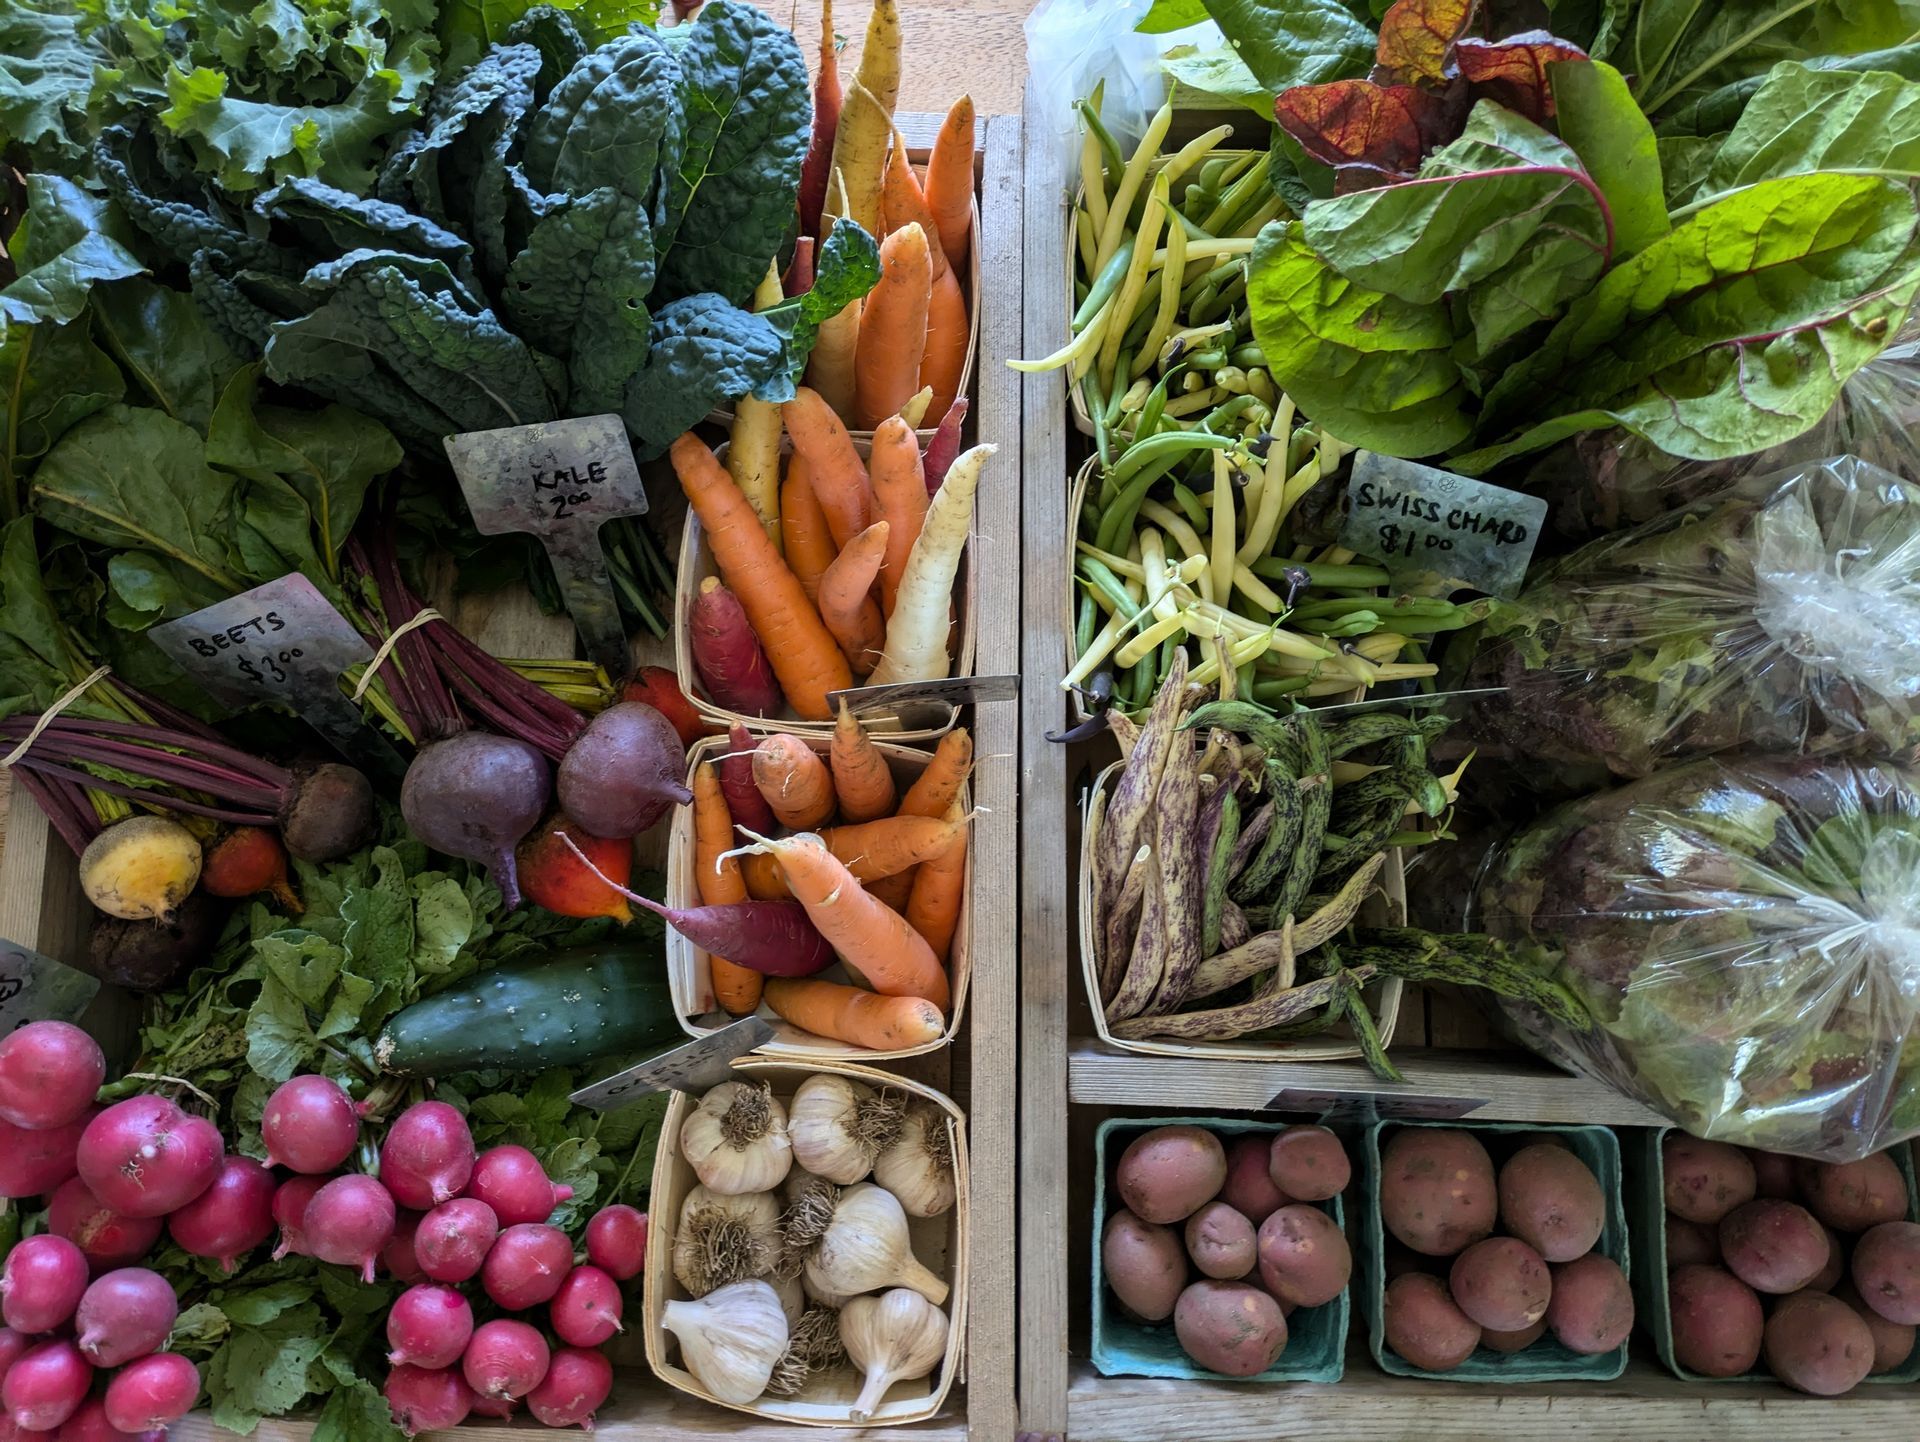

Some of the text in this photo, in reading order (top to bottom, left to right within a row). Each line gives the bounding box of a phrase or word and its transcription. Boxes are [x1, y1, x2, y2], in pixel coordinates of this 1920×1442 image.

[531, 461, 608, 492] KALE
[1357, 482, 1527, 546] SWISS CHARD
[187, 611, 286, 657] BEETS
